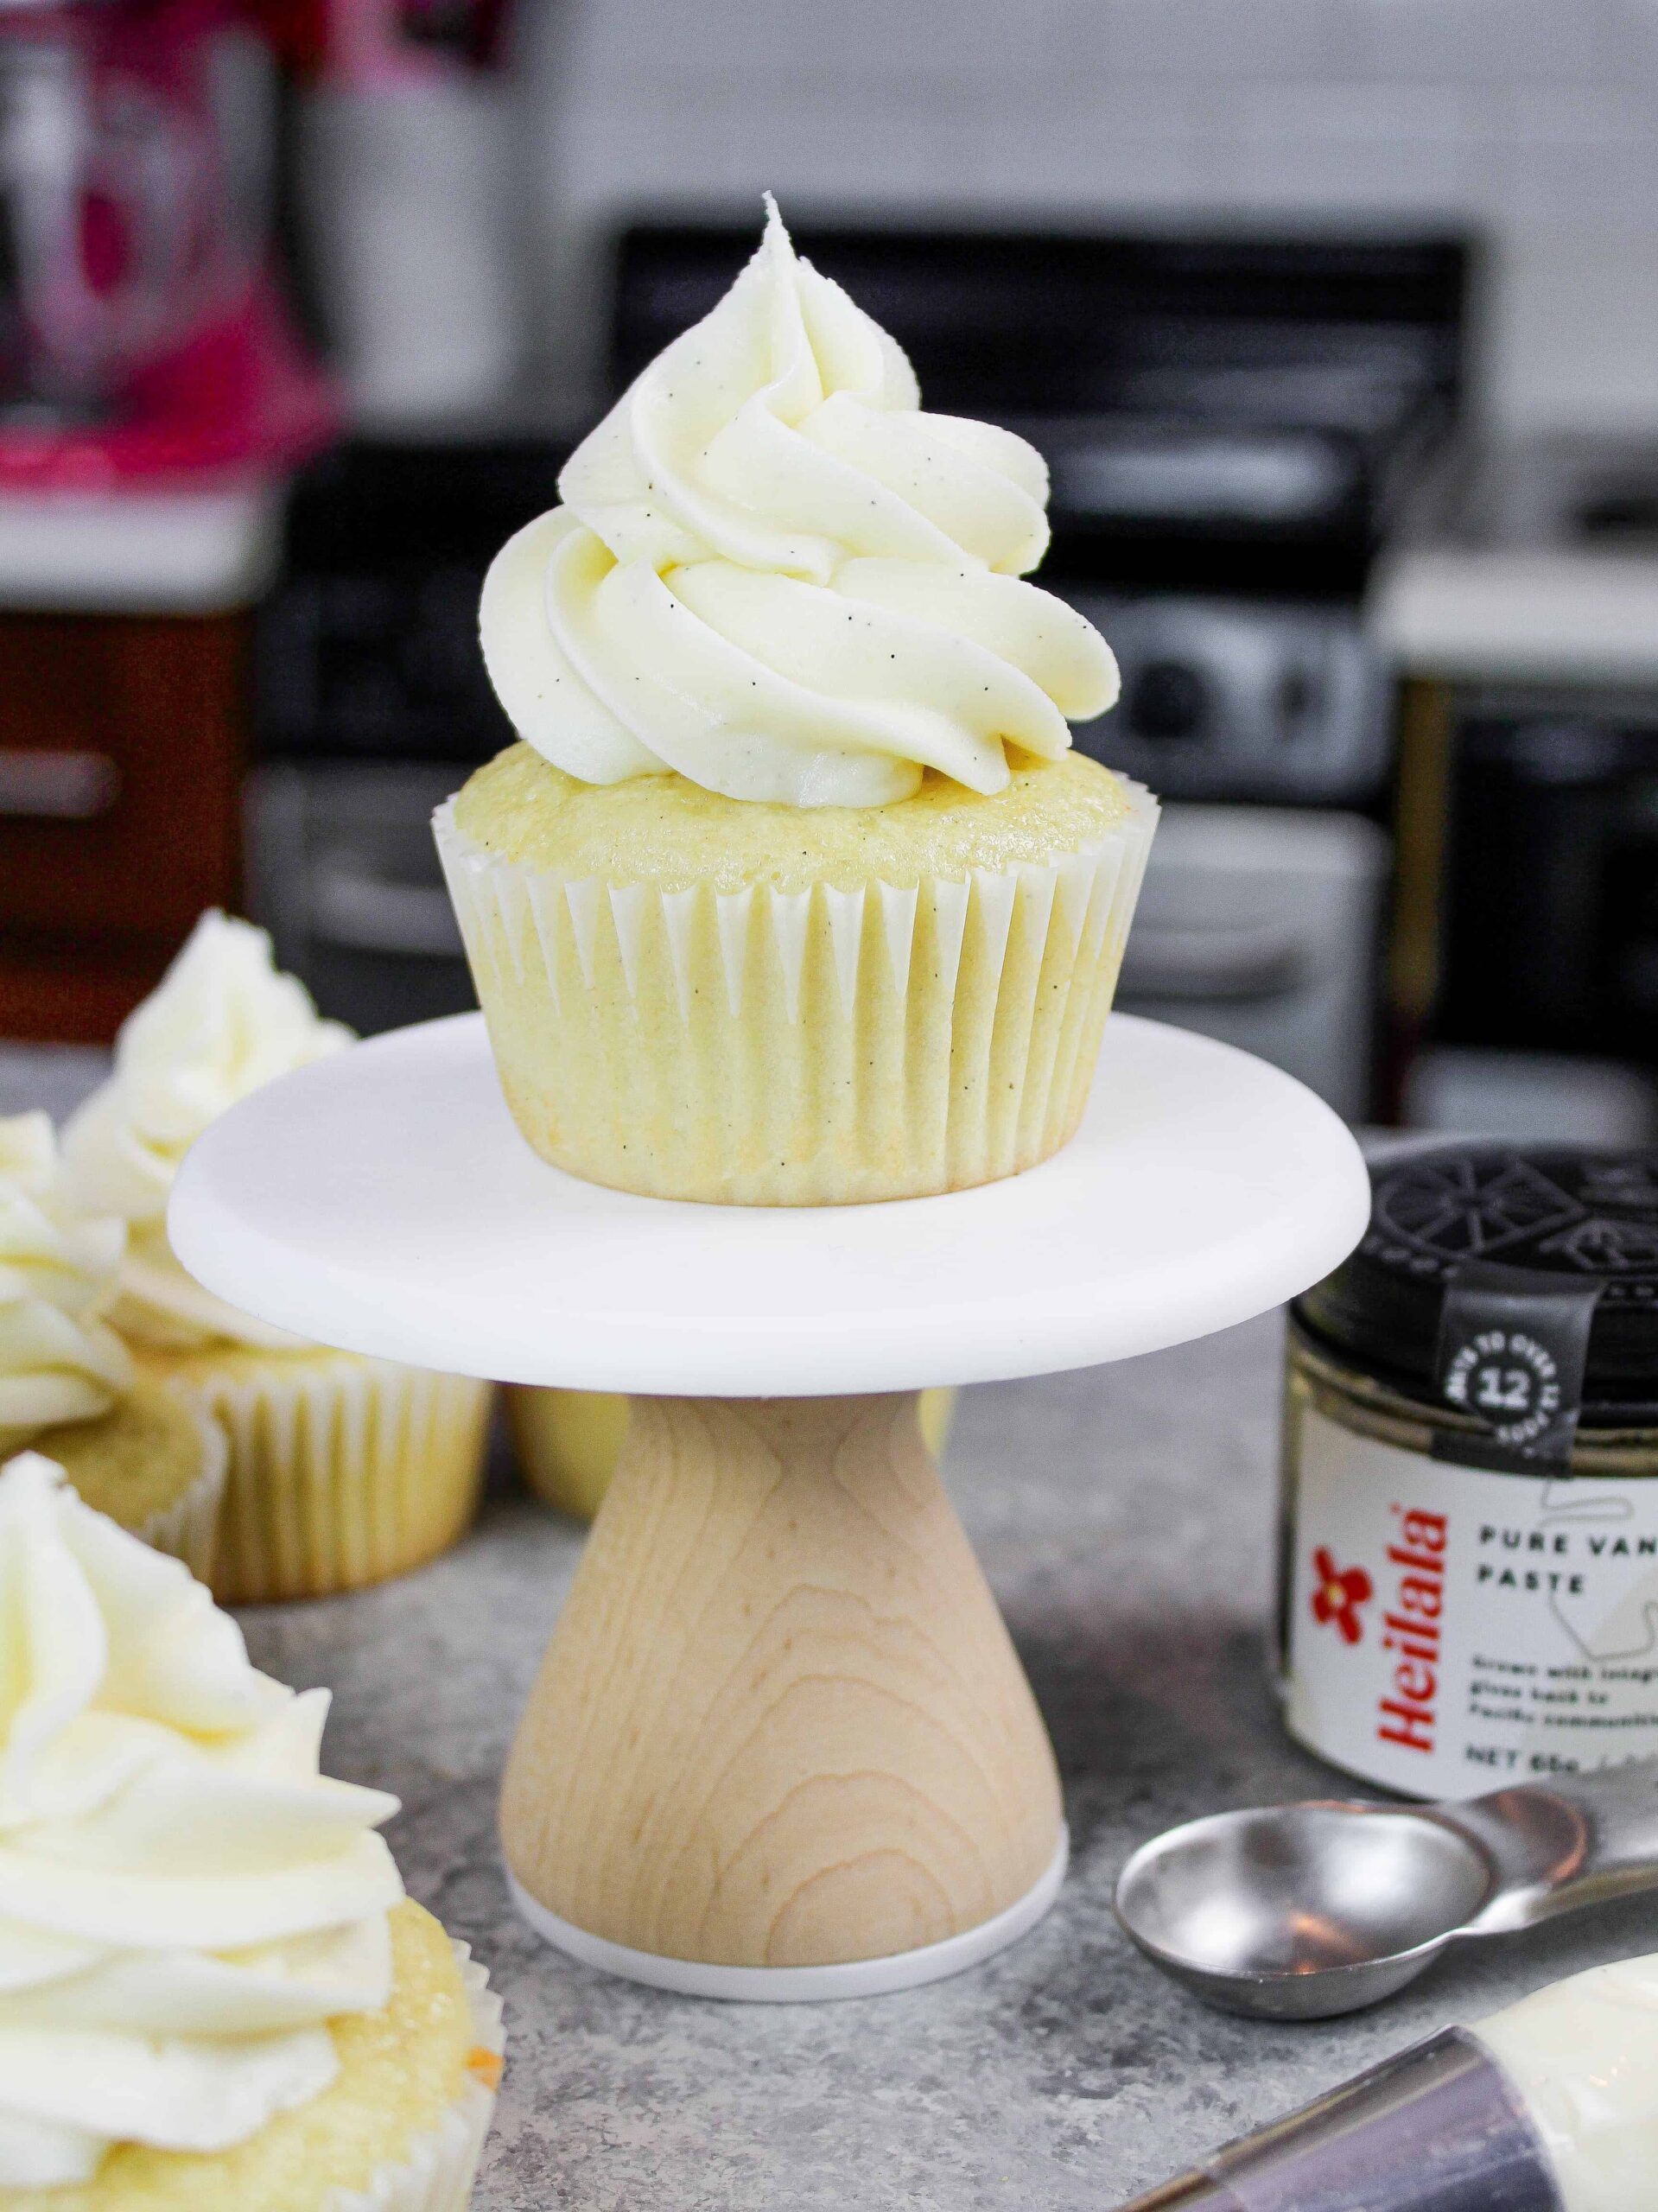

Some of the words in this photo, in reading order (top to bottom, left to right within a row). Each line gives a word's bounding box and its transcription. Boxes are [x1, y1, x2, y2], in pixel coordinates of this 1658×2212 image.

[1477, 1367, 1531, 1408] 12
[1479, 1523, 1569, 1554] PURE
[1477, 1562, 1584, 1594] PASTE
[1377, 1507, 1449, 1752] Heilala
[1547, 1664, 1591, 1679] with
[1531, 1686, 1579, 1704] back
[1586, 1690, 1609, 1705] to
[1465, 1738, 1520, 1766] NET
